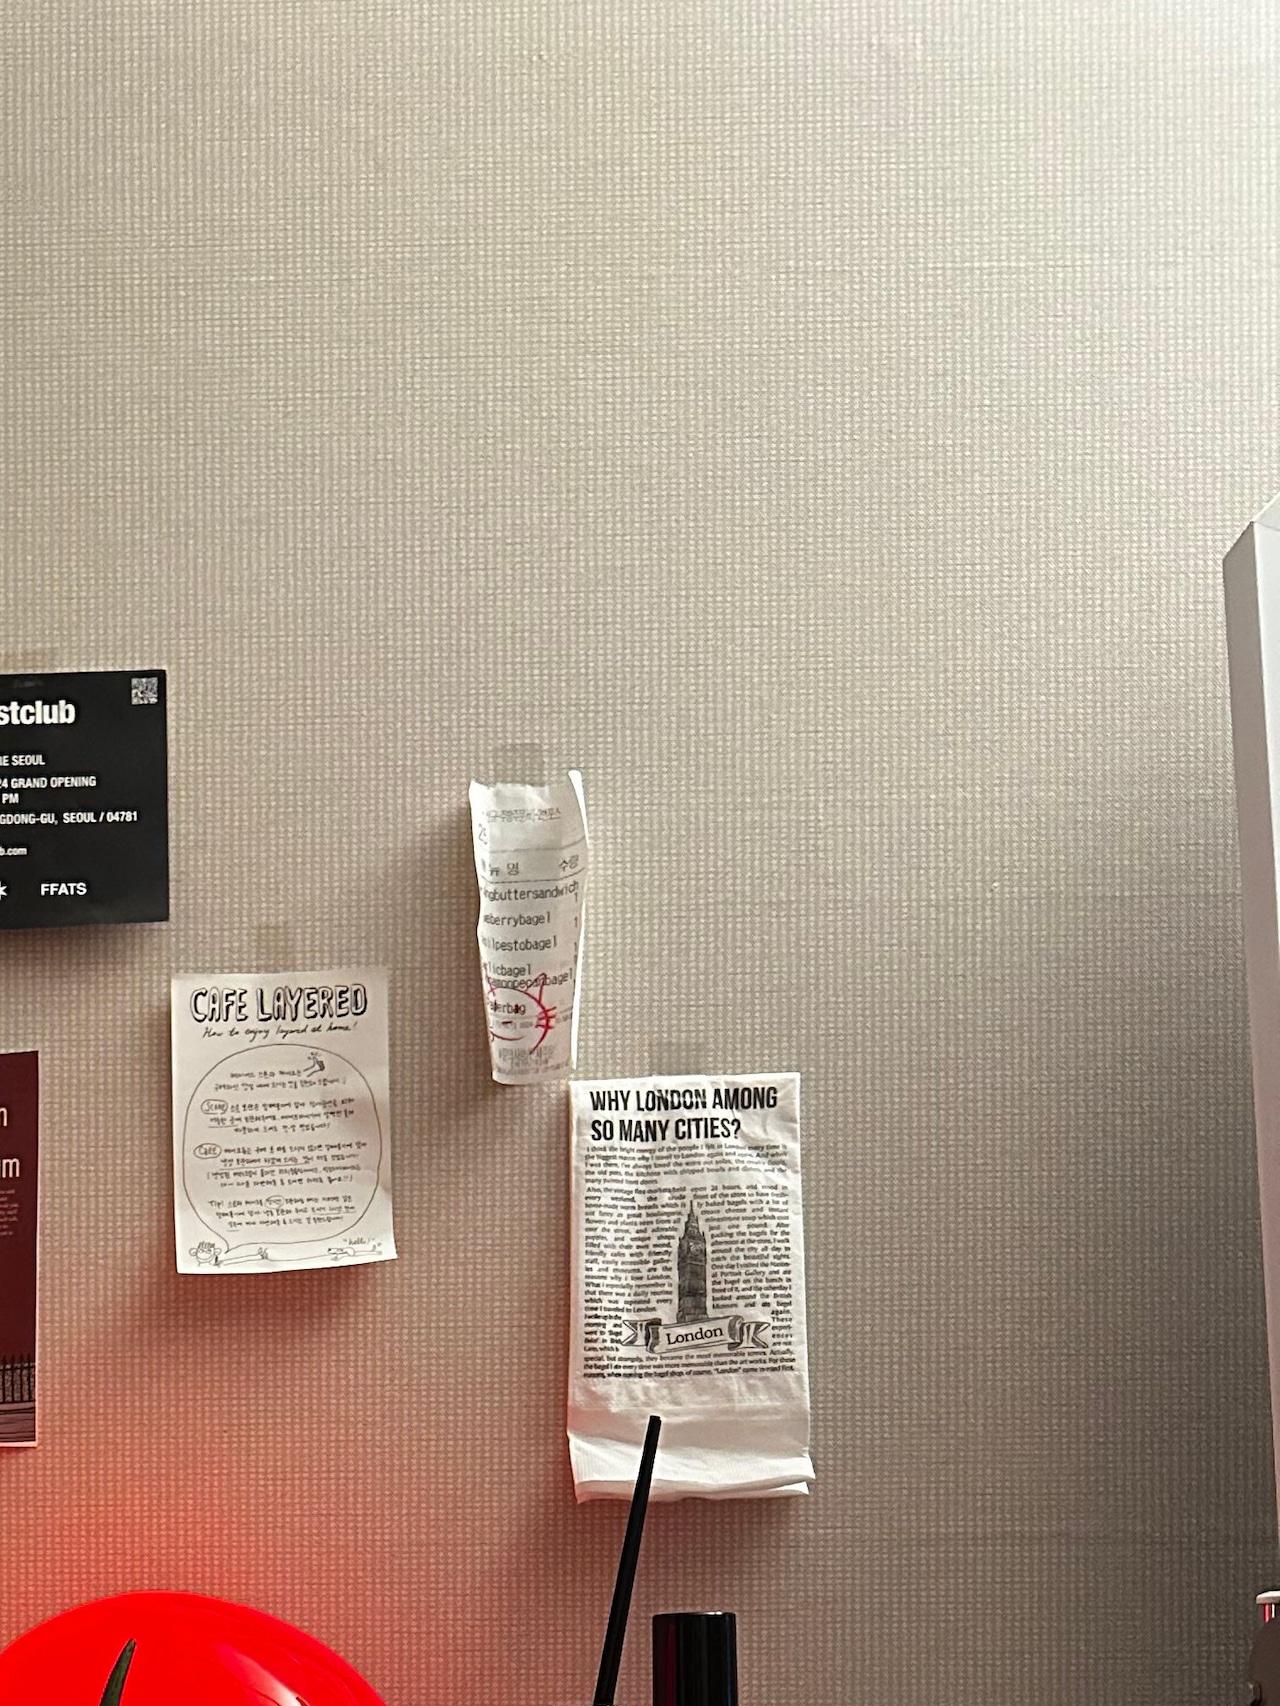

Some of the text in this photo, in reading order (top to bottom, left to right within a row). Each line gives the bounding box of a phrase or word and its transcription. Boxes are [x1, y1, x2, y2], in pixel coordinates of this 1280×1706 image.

[11, 755, 45, 766] SEOUL
[11, 778, 47, 789] GRAND
[50, 776, 96, 788] OPENING
[2, 794, 18, 804] PM
[63, 812, 96, 823] SEOUL
[106, 811, 138, 823] 04781
[40, 882, 87, 896] FFATS
[190, 984, 367, 1023] CAFE LAYERED
[202, 1027, 222, 1038] How
[228, 1028, 239, 1036] to
[590, 1087, 777, 1111] WHY LONDON AMONG
[591, 1117, 741, 1142] SO MANY CITIES?
[666, 1326, 724, 1345] London
